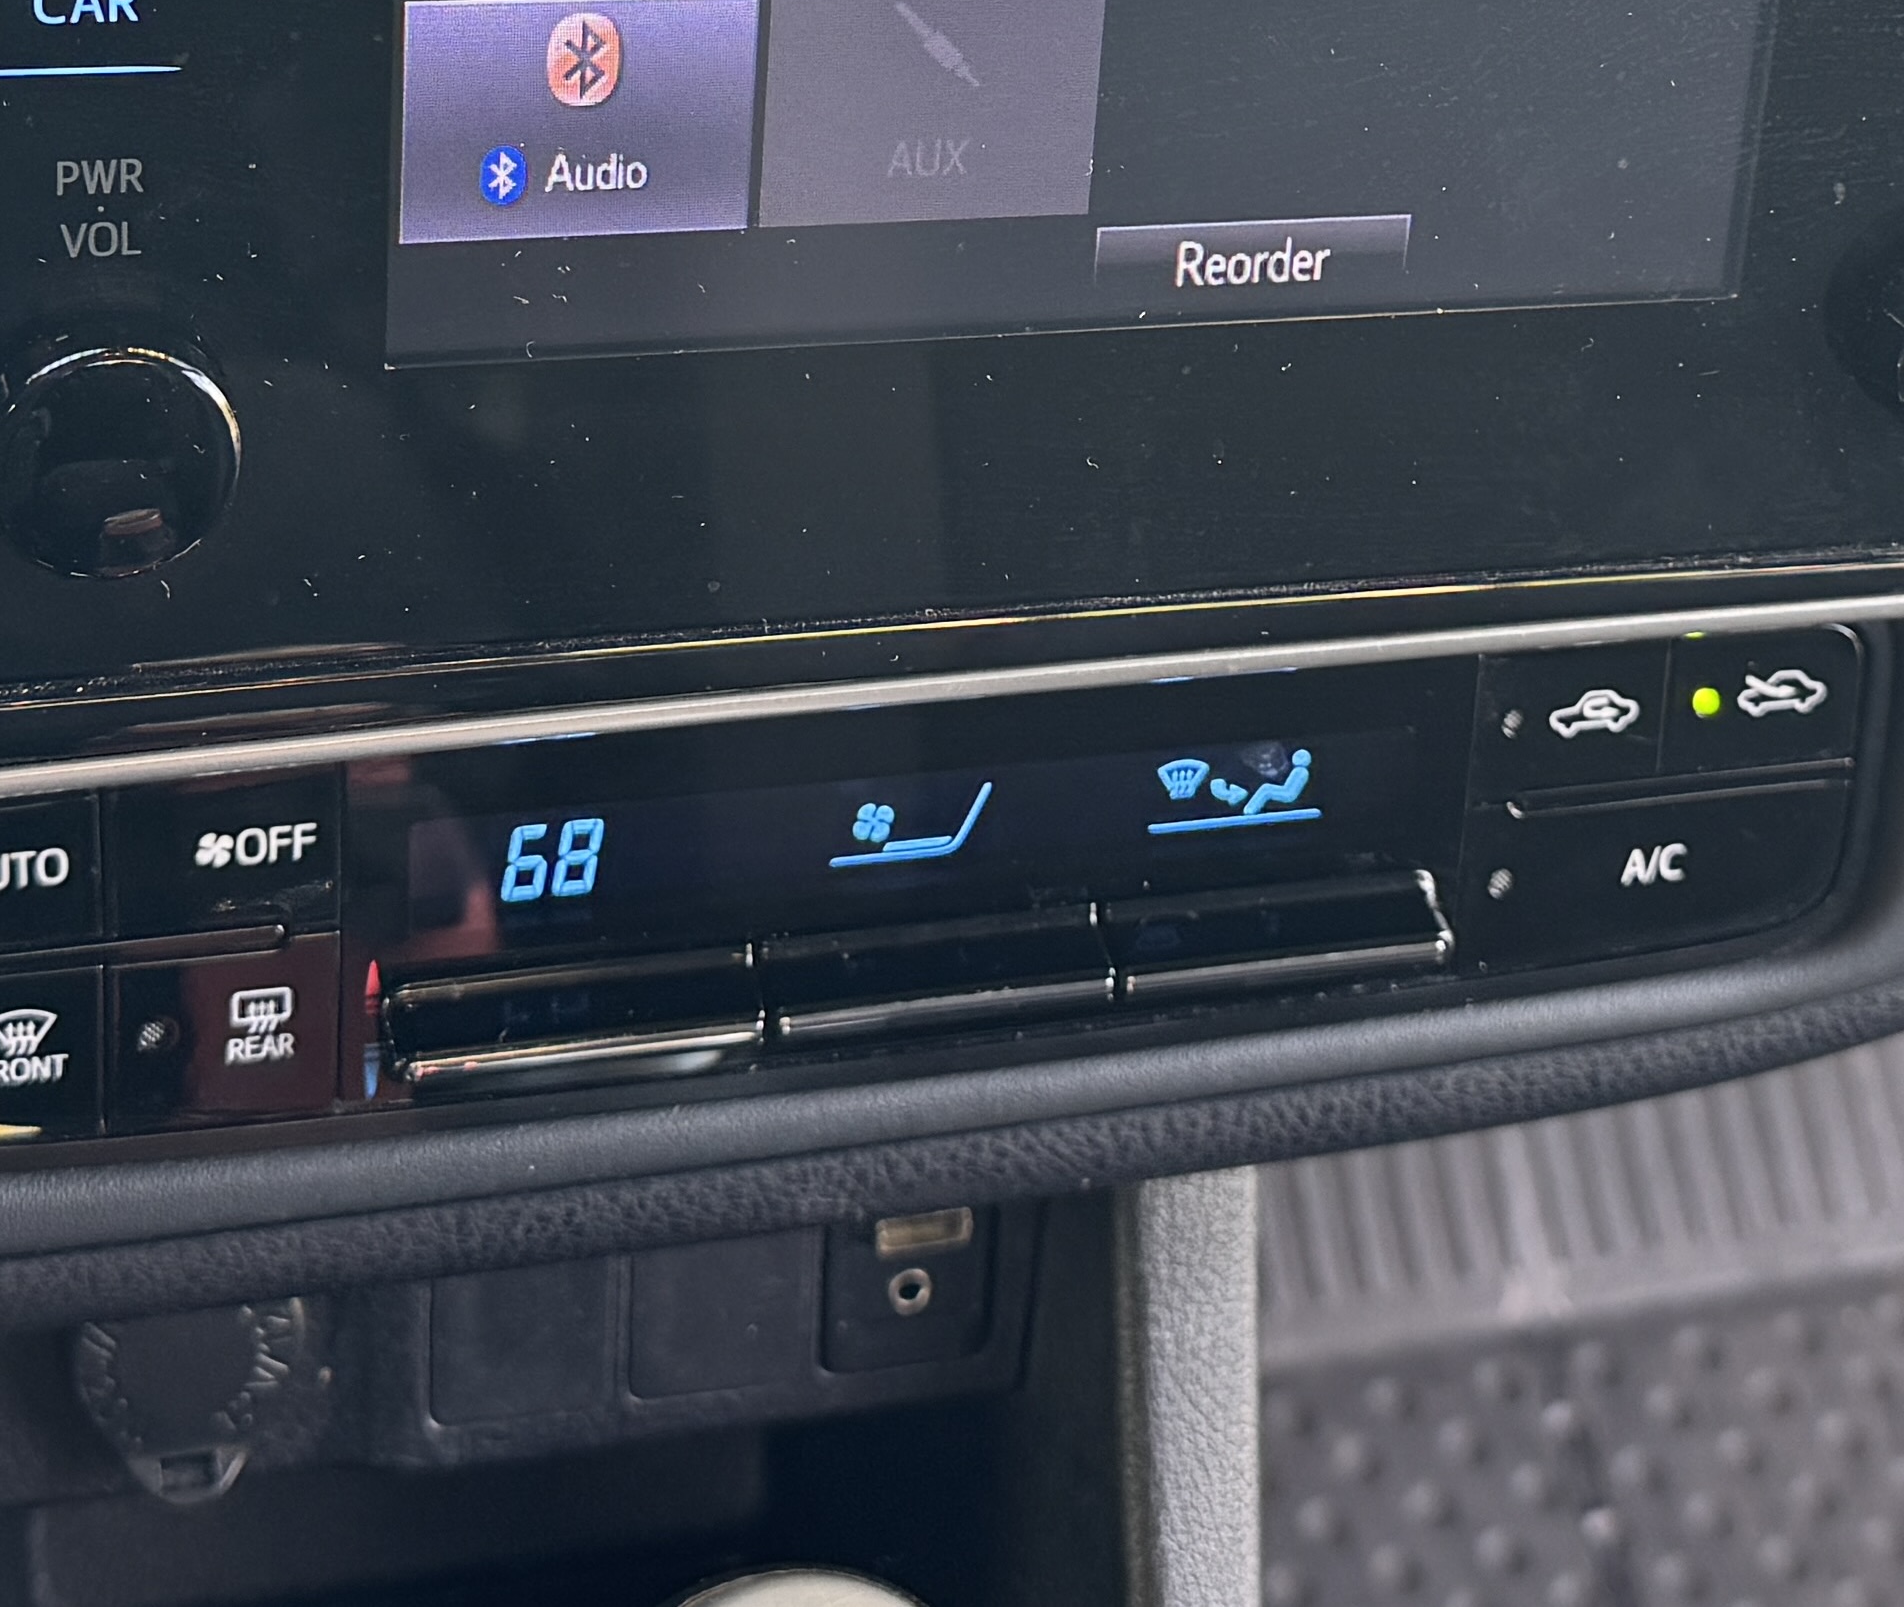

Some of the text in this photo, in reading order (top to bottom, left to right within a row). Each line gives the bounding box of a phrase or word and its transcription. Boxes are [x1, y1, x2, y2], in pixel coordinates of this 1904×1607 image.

[56, 158, 145, 197] PWR
[543, 152, 649, 194] Audio
[887, 138, 972, 178] AUX
[60, 221, 143, 259] VOL
[1174, 237, 1332, 289] Reorder
[233, 821, 319, 867] OFF
[500, 817, 605, 903] 68
[1620, 841, 1689, 888] A/C
[224, 1032, 296, 1066] REAR
